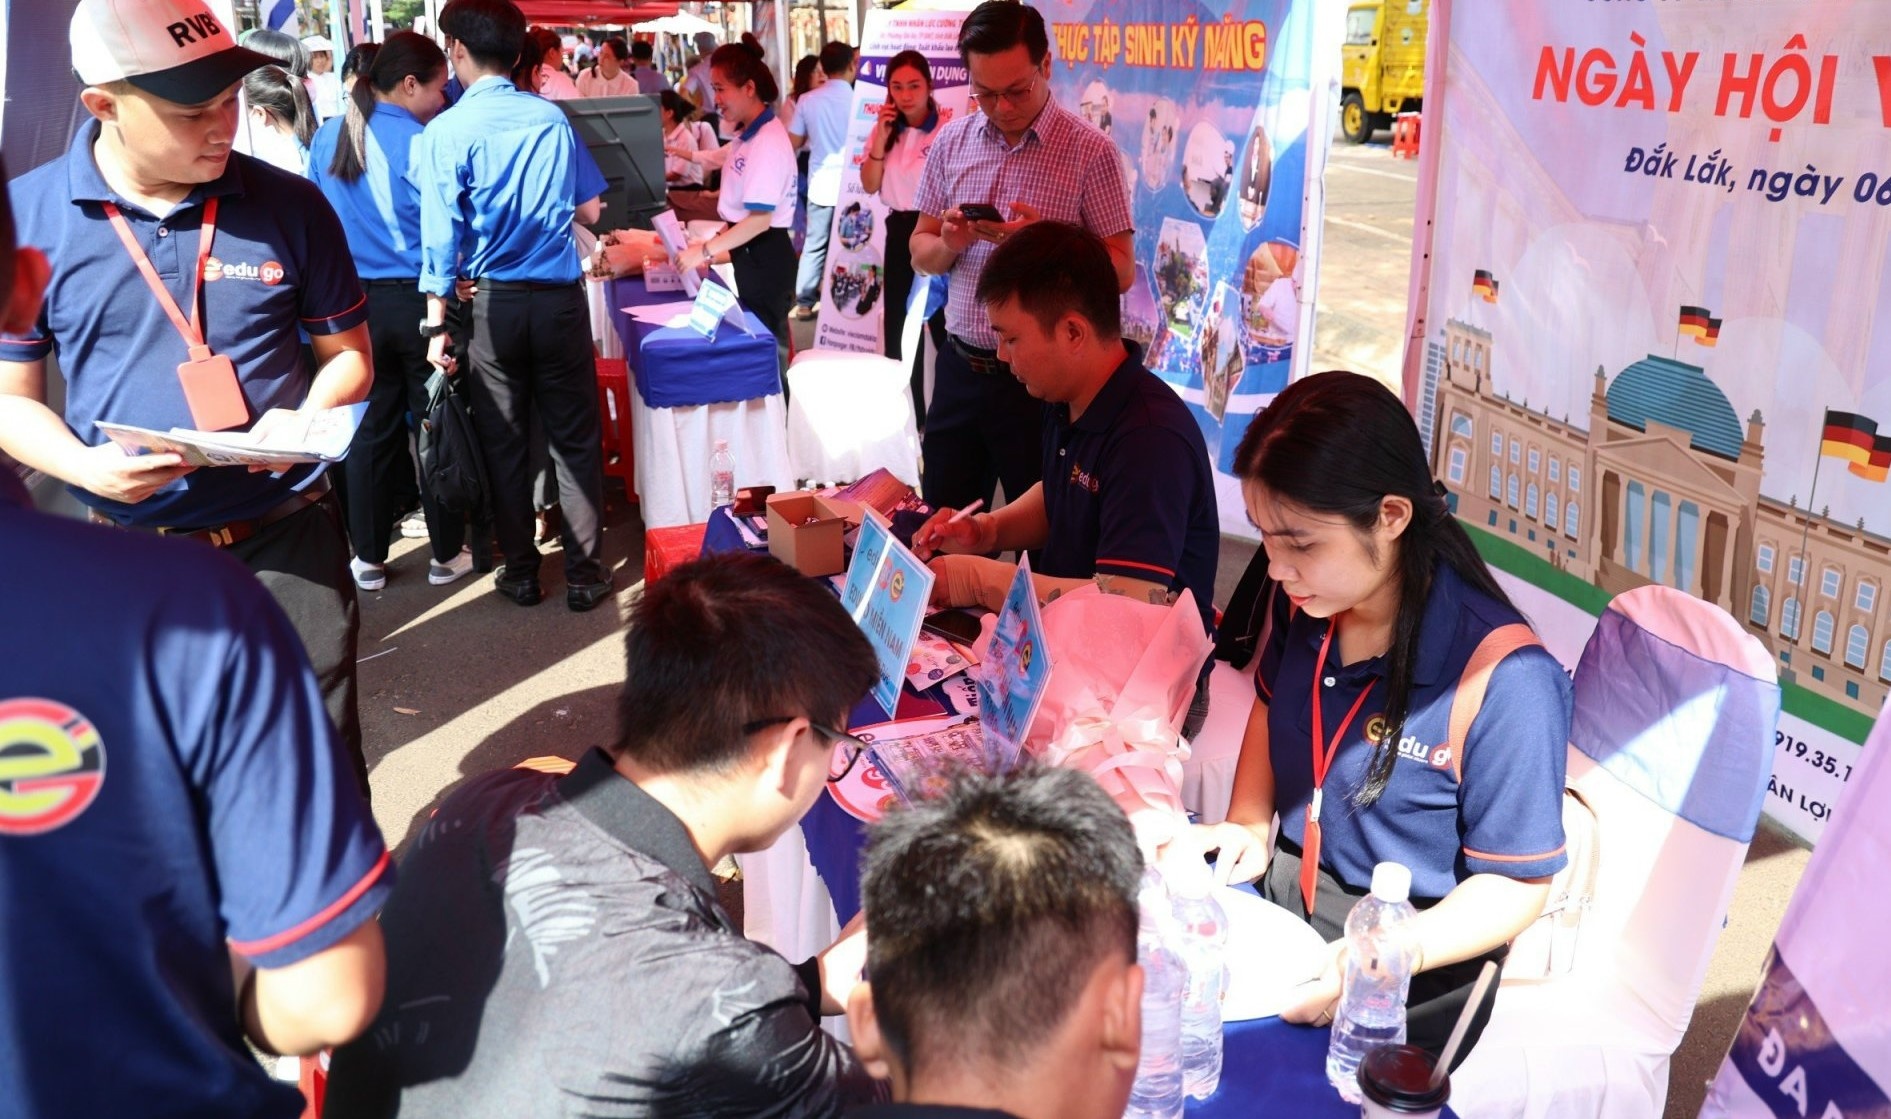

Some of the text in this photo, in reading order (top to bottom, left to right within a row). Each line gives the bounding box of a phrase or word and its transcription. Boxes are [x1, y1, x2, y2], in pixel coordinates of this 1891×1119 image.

[166, 13, 221, 48] RVB
[1092, 17, 1121, 70] TẬP
[1124, 22, 1167, 68] SINH
[1170, 14, 1200, 69] KỸ
[1203, 12, 1267, 72] NĂNG
[936, 66, 968, 84] DỤNG
[1532, 30, 1700, 113] NGÀY
[1714, 33, 1839, 143] HỘI
[1624, 142, 1891, 205] Đắk Lắk, ngày 06
[1386, 736, 1429, 759] du
